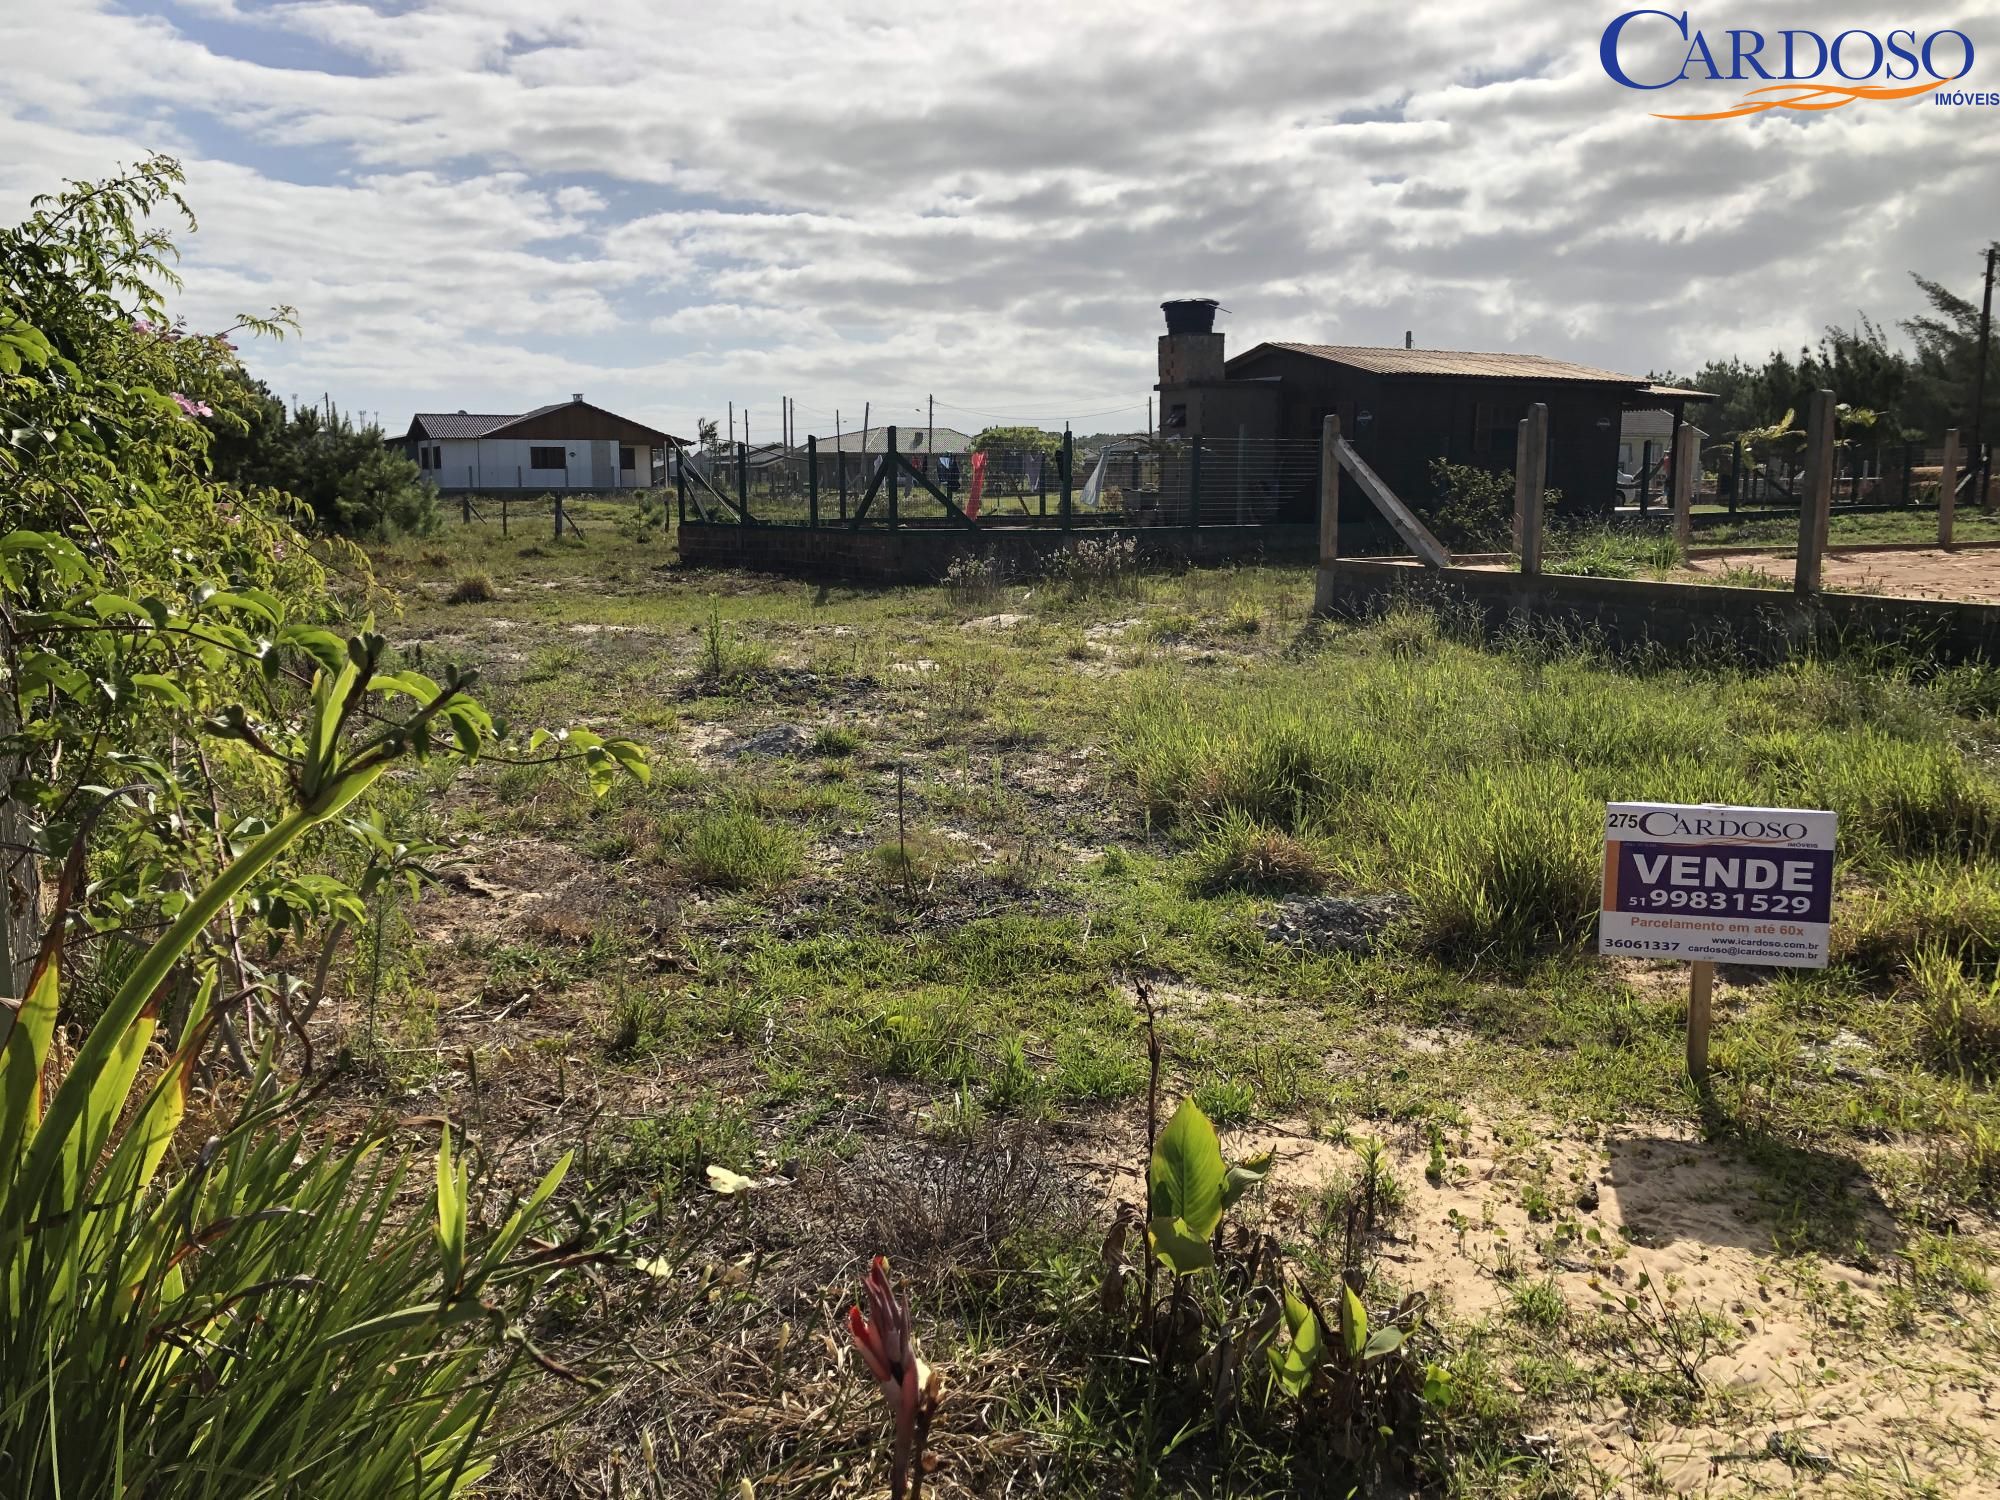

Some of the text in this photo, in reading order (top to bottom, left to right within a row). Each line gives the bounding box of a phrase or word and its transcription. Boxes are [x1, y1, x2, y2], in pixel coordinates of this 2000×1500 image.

[1608, 813, 1637, 828] 275
[1638, 811, 1808, 840] CARDOSO
[1632, 853, 1814, 891] VENDE
[1628, 889, 1811, 914] 51 99831529
[1631, 916, 1804, 936] Parcelamento em até 60x
[1605, 938, 1680, 952] 36061337
[1711, 937, 1820, 950] www.icardoso.com.br
[1688, 946, 1819, 959] cardoso@icardoso.com.br
